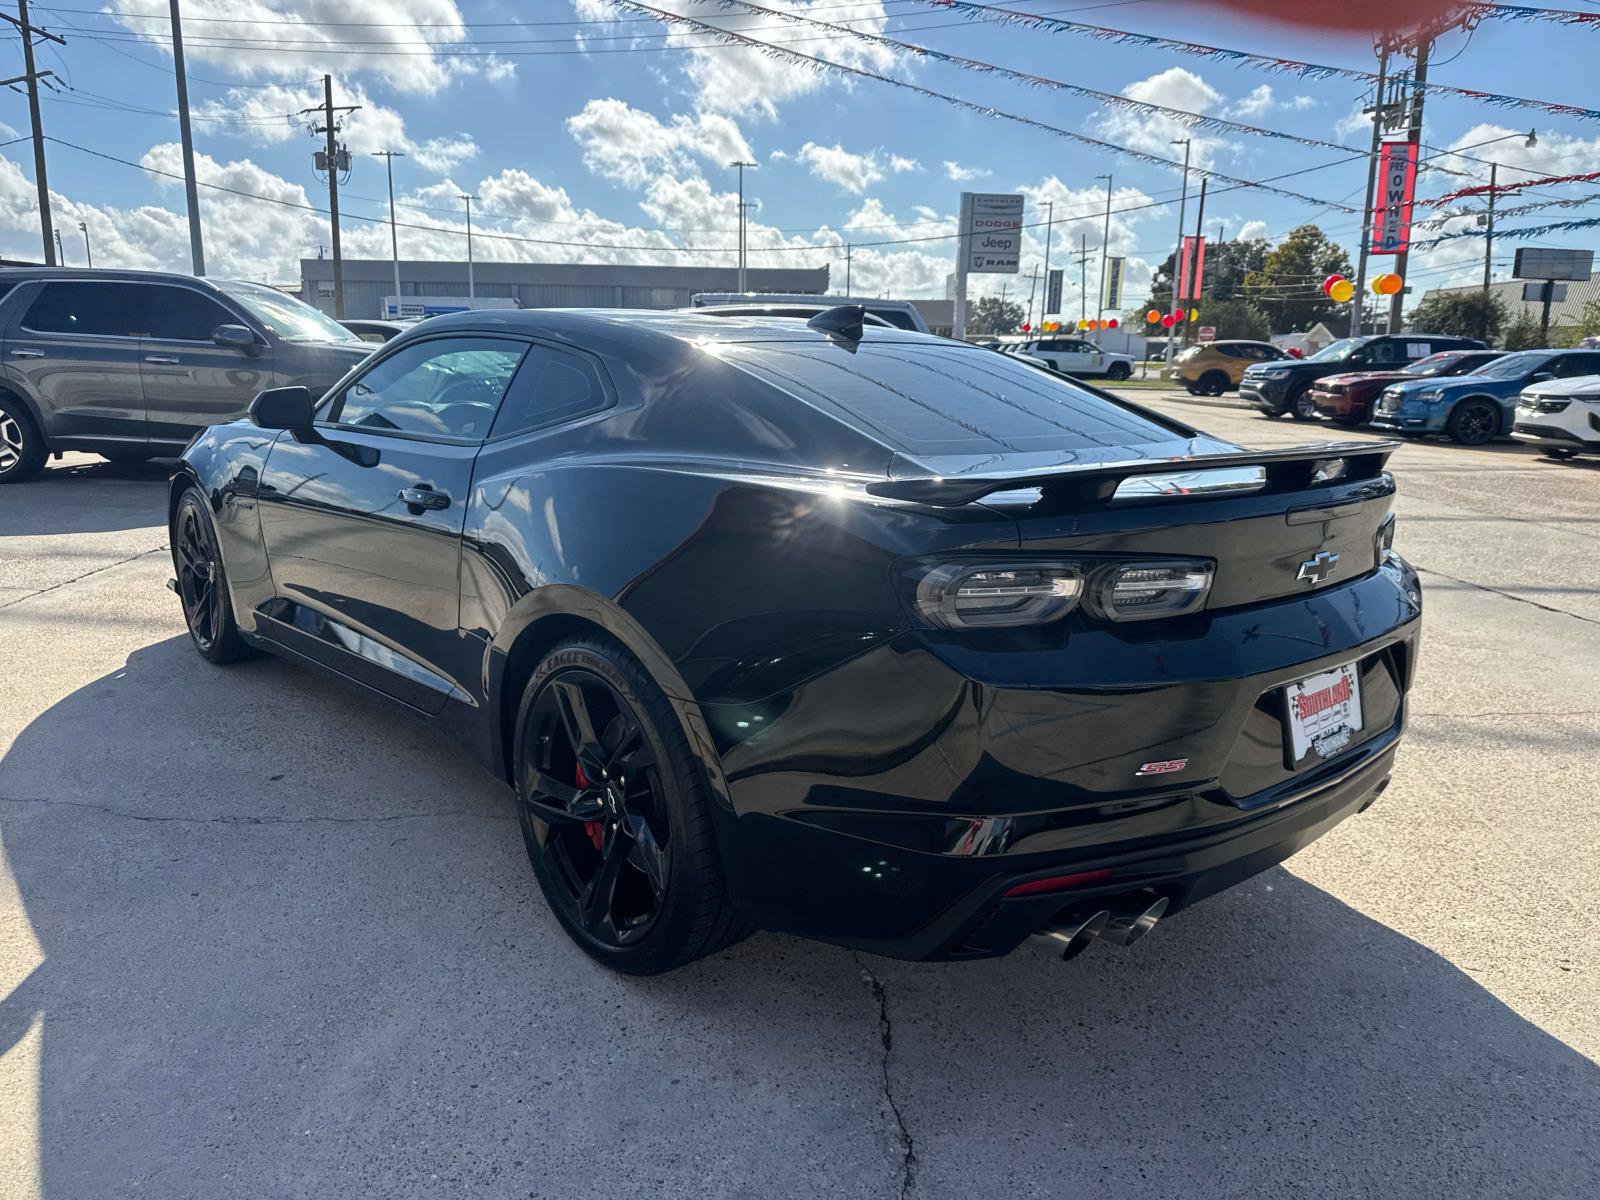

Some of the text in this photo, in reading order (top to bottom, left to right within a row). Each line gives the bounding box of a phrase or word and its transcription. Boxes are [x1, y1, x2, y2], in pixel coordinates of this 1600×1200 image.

[1390, 161, 1407, 172] PRE-
[975, 220, 1020, 229] DODGE
[982, 236, 1012, 250] Jeep
[986, 259, 1018, 267] RAM
[547, 652, 579, 669] EAGLE
[1297, 675, 1350, 720] SOUTHLAND
[1137, 757, 1189, 775] SS
